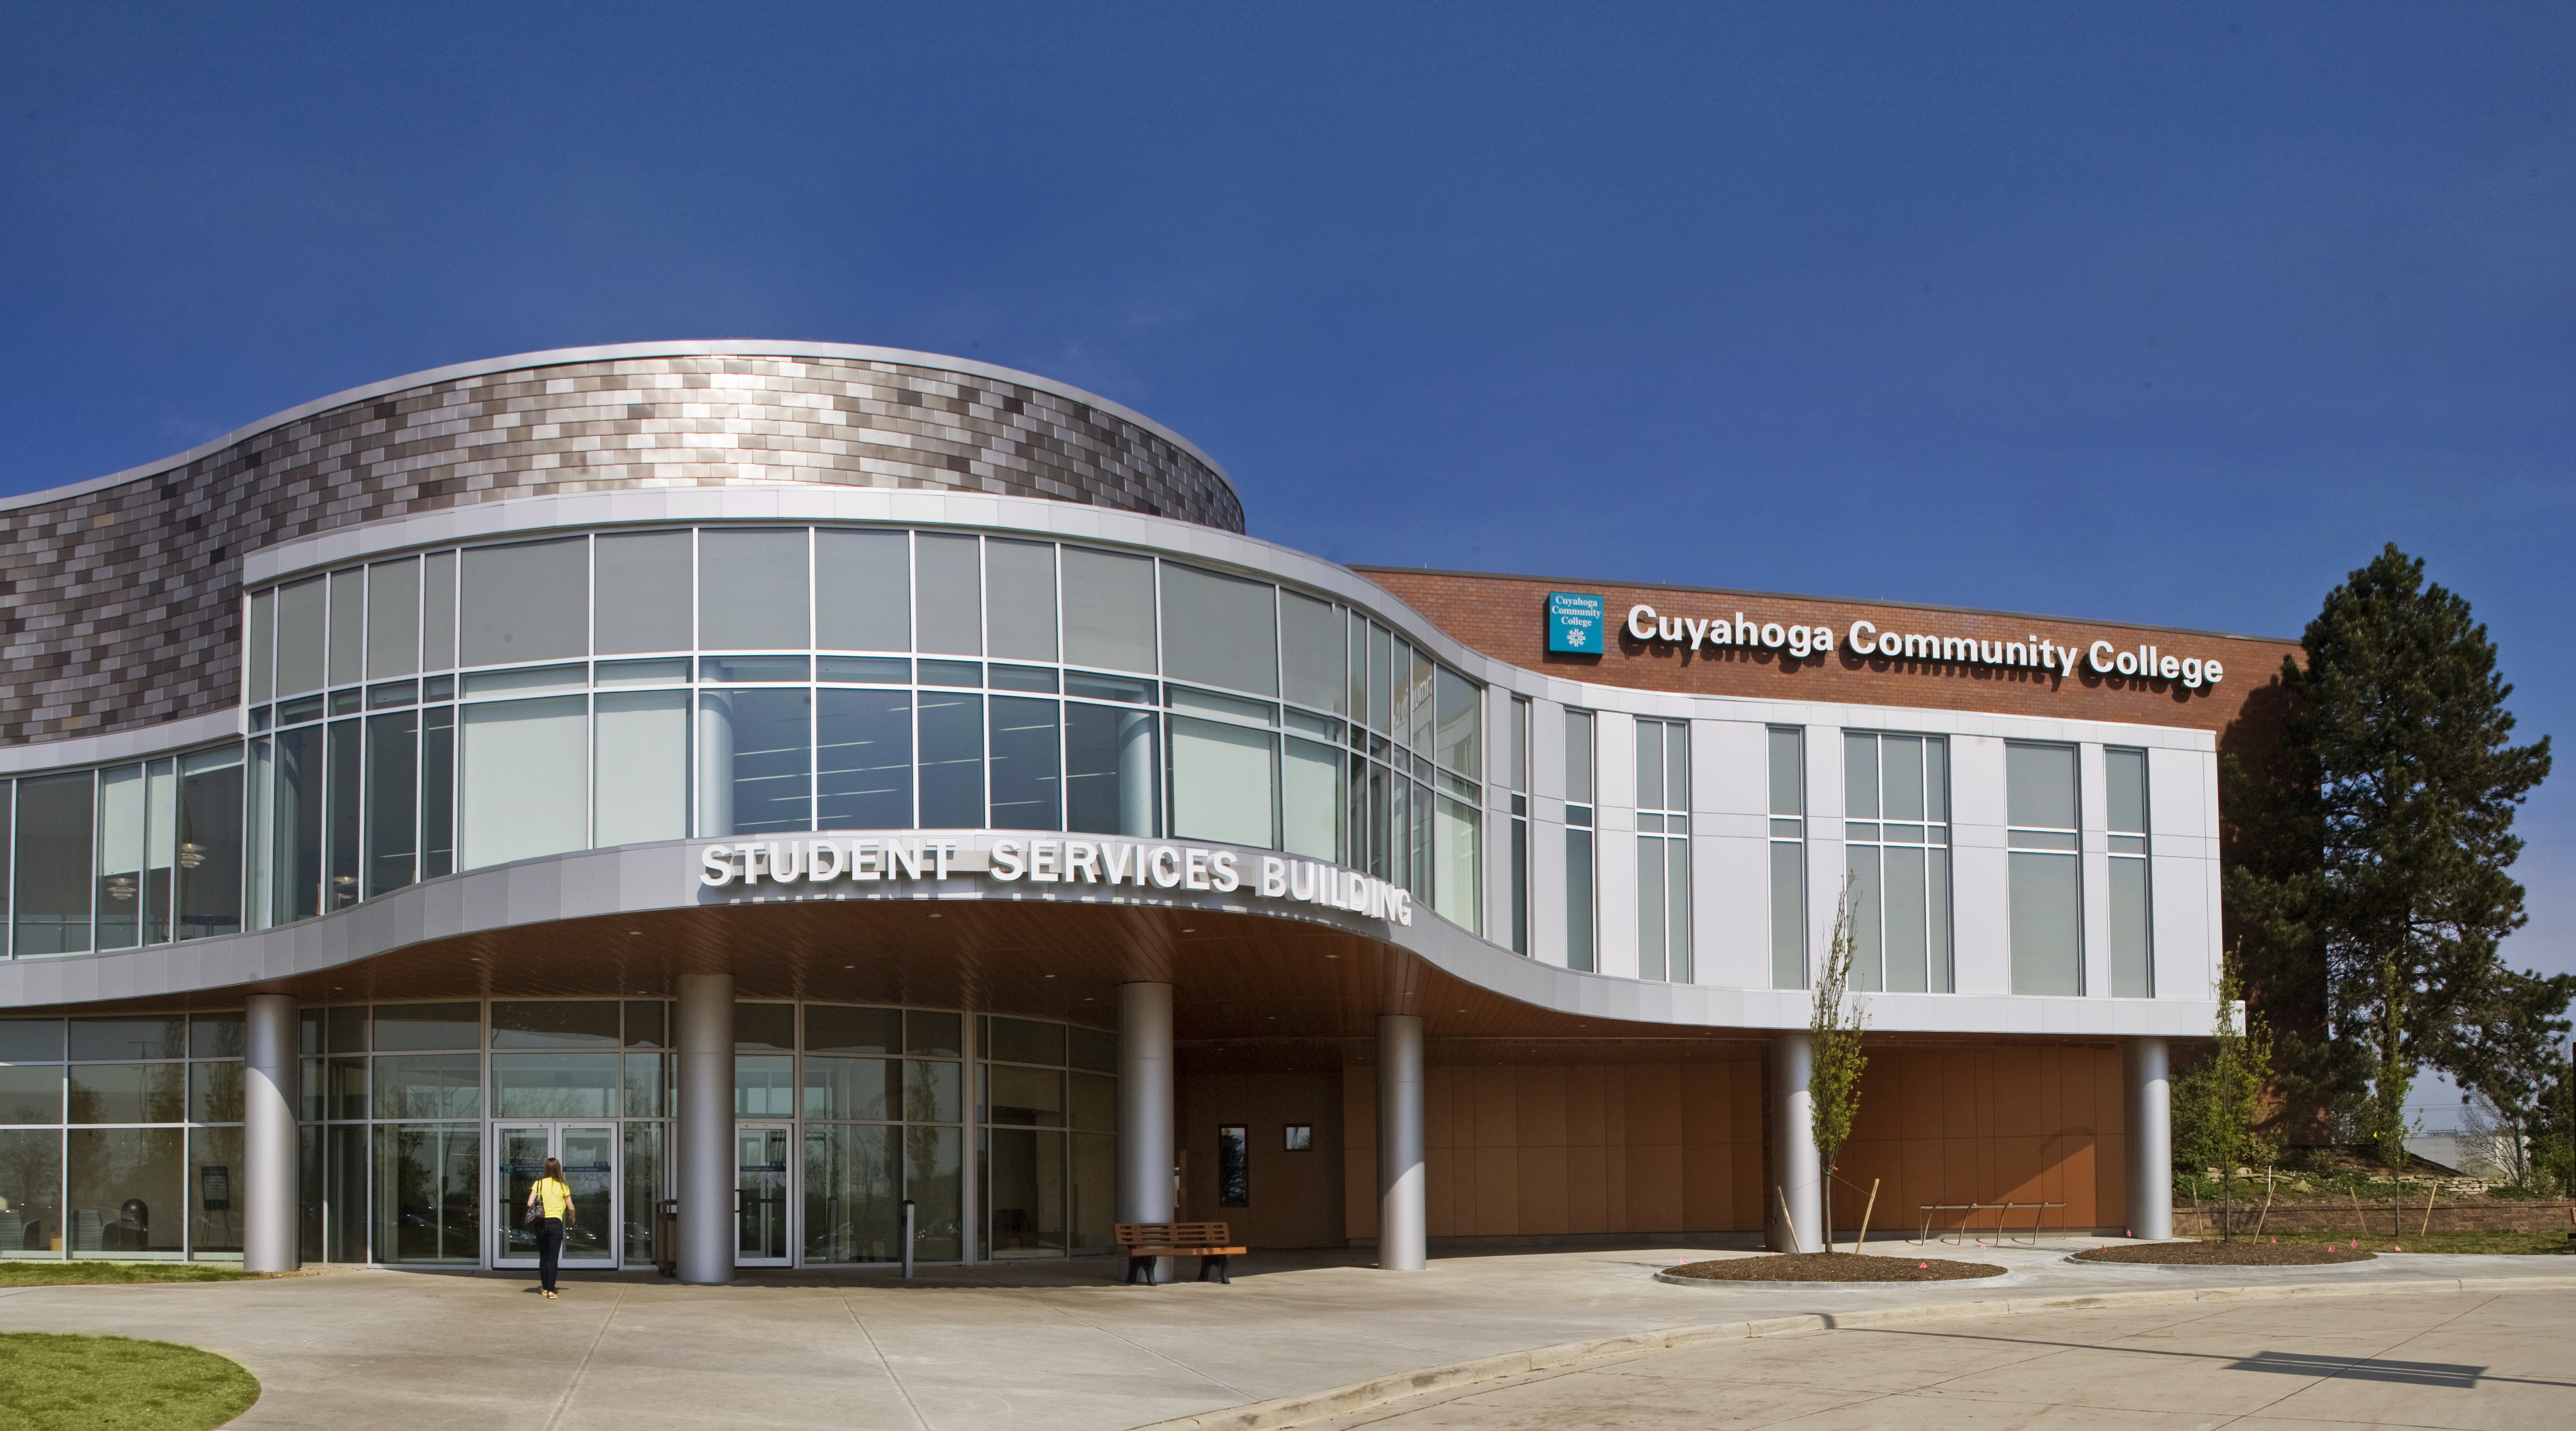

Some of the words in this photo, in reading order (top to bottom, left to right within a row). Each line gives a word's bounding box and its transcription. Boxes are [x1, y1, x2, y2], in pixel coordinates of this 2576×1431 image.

[1556, 596, 1598, 608] Cuyahoga
[1552, 605, 1601, 619] Community
[1561, 616, 1592, 628] College
[1628, 604, 1834, 657] Cuyahoga
[1849, 620, 2078, 677] Community
[2089, 641, 2223, 688] College
[700, 838, 957, 887] STUDENT
[989, 838, 1239, 893] SERVICES
[1255, 856, 1412, 927] BUILDING
